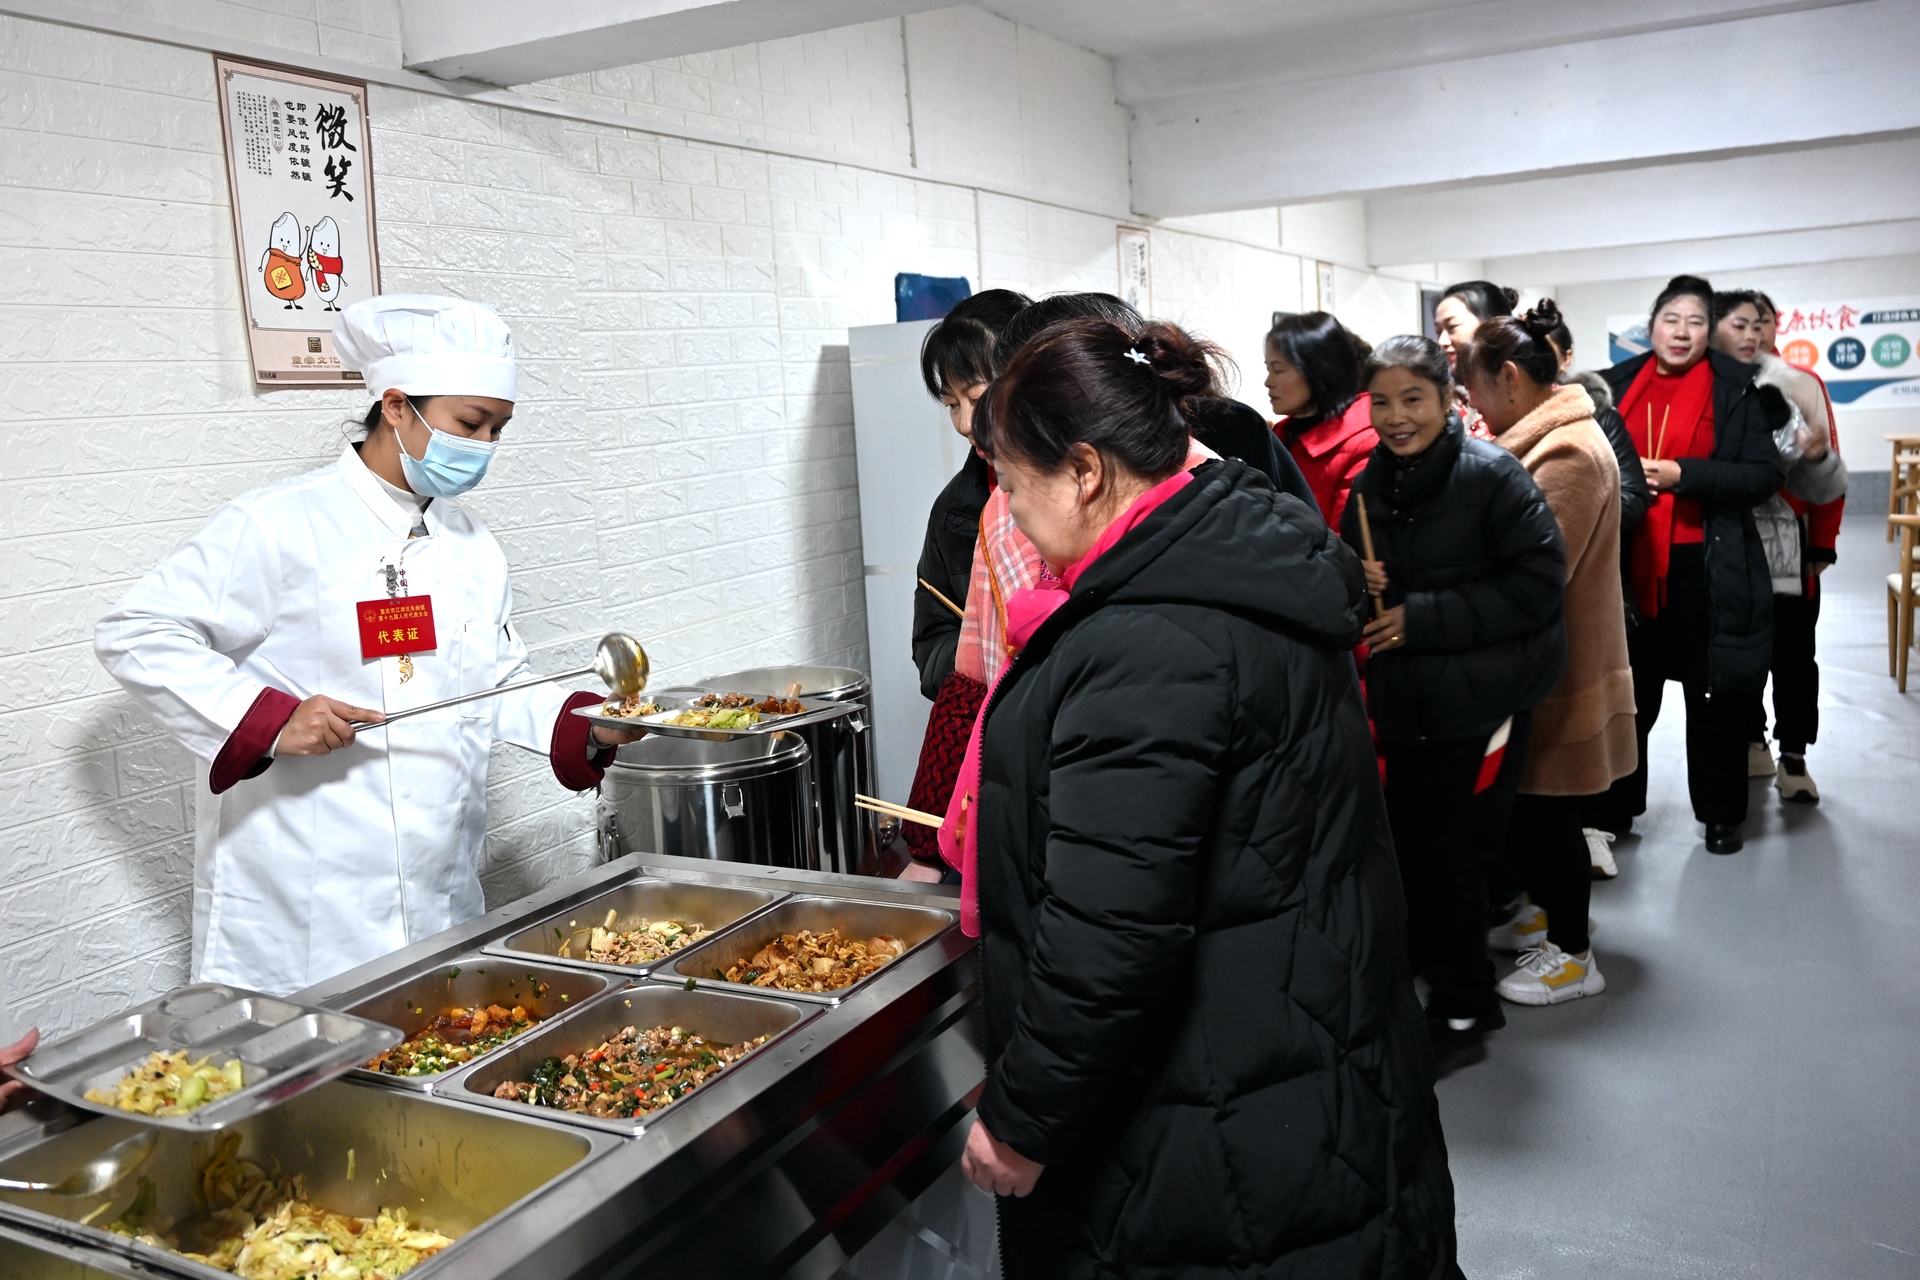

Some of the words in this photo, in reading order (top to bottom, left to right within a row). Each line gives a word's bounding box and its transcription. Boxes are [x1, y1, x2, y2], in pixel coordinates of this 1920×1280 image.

[283, 100, 301, 180] 也要风度依然
[296, 102, 312, 181] 即使饥肠辘辘
[313, 102, 357, 202] 微笑
[399, 569, 408, 587] 中国
[377, 627, 419, 645] 代表证
[378, 611, 428, 622] 第十九届人民代表大会
